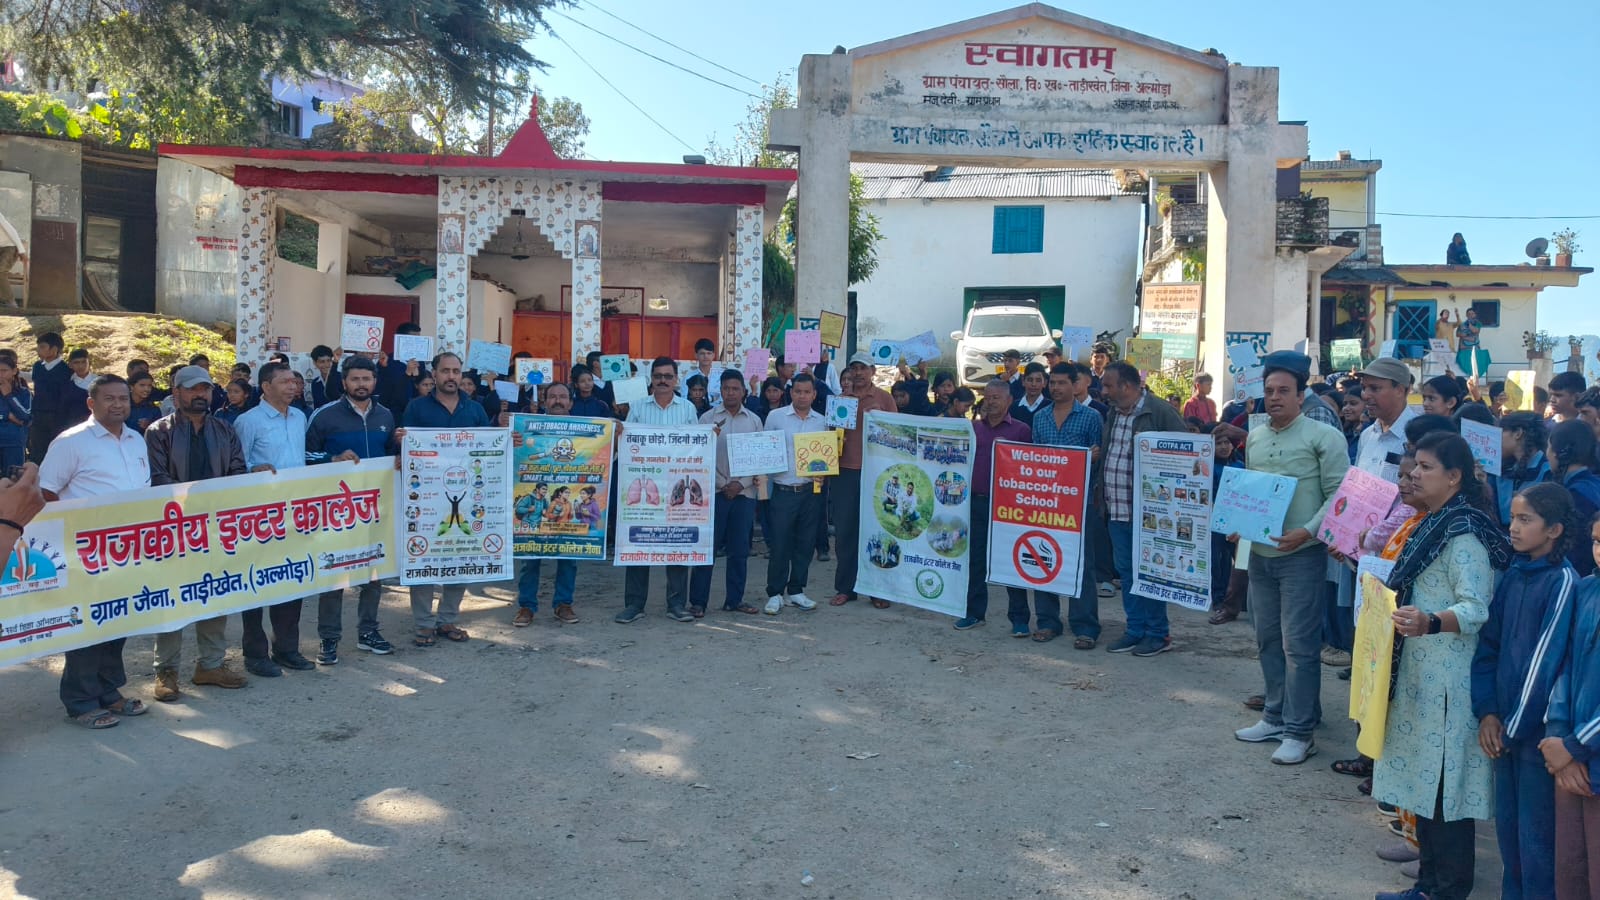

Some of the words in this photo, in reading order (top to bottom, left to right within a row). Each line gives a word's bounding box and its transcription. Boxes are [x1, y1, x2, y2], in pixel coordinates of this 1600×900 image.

[965, 43, 1117, 75] स्वागतम्
[922, 76, 946, 89] ग्राम
[528, 421, 567, 431] ANTI-TOBACCO
[568, 423, 601, 433] AWARENESS
[626, 432, 647, 446] तंबाकू
[1158, 441, 1178, 450] COTPA
[1179, 442, 1192, 450] ACT
[1011, 449, 1069, 465] Welcome
[1020, 465, 1033, 476] to
[1037, 468, 1057, 478] our
[999, 477, 1078, 496] tobacco-free
[1016, 493, 1059, 508] School
[997, 506, 1024, 521] GIC
[1028, 510, 1077, 529] JAINA
[76, 501, 209, 575] राजकीय
[216, 501, 286, 553] इन्टर
[290, 480, 380, 535] कालेज
[513, 540, 541, 553] राजकीय
[543, 542, 557, 553] इंटर
[559, 542, 583, 554] कॉलेज
[584, 543, 601, 555] जैना
[620, 550, 649, 562] राजकीय
[666, 551, 689, 562] कॉलेज
[405, 565, 439, 579] राजकीय
[440, 564, 456, 577] इंटर
[458, 563, 484, 576] कॉलेज
[485, 562, 503, 575] जैना
[90, 596, 128, 625] ग्राम
[133, 585, 175, 611] जैना,
[180, 570, 248, 604] ताड़ीखेत,
[249, 553, 315, 594] (अल्मोड़ा)
